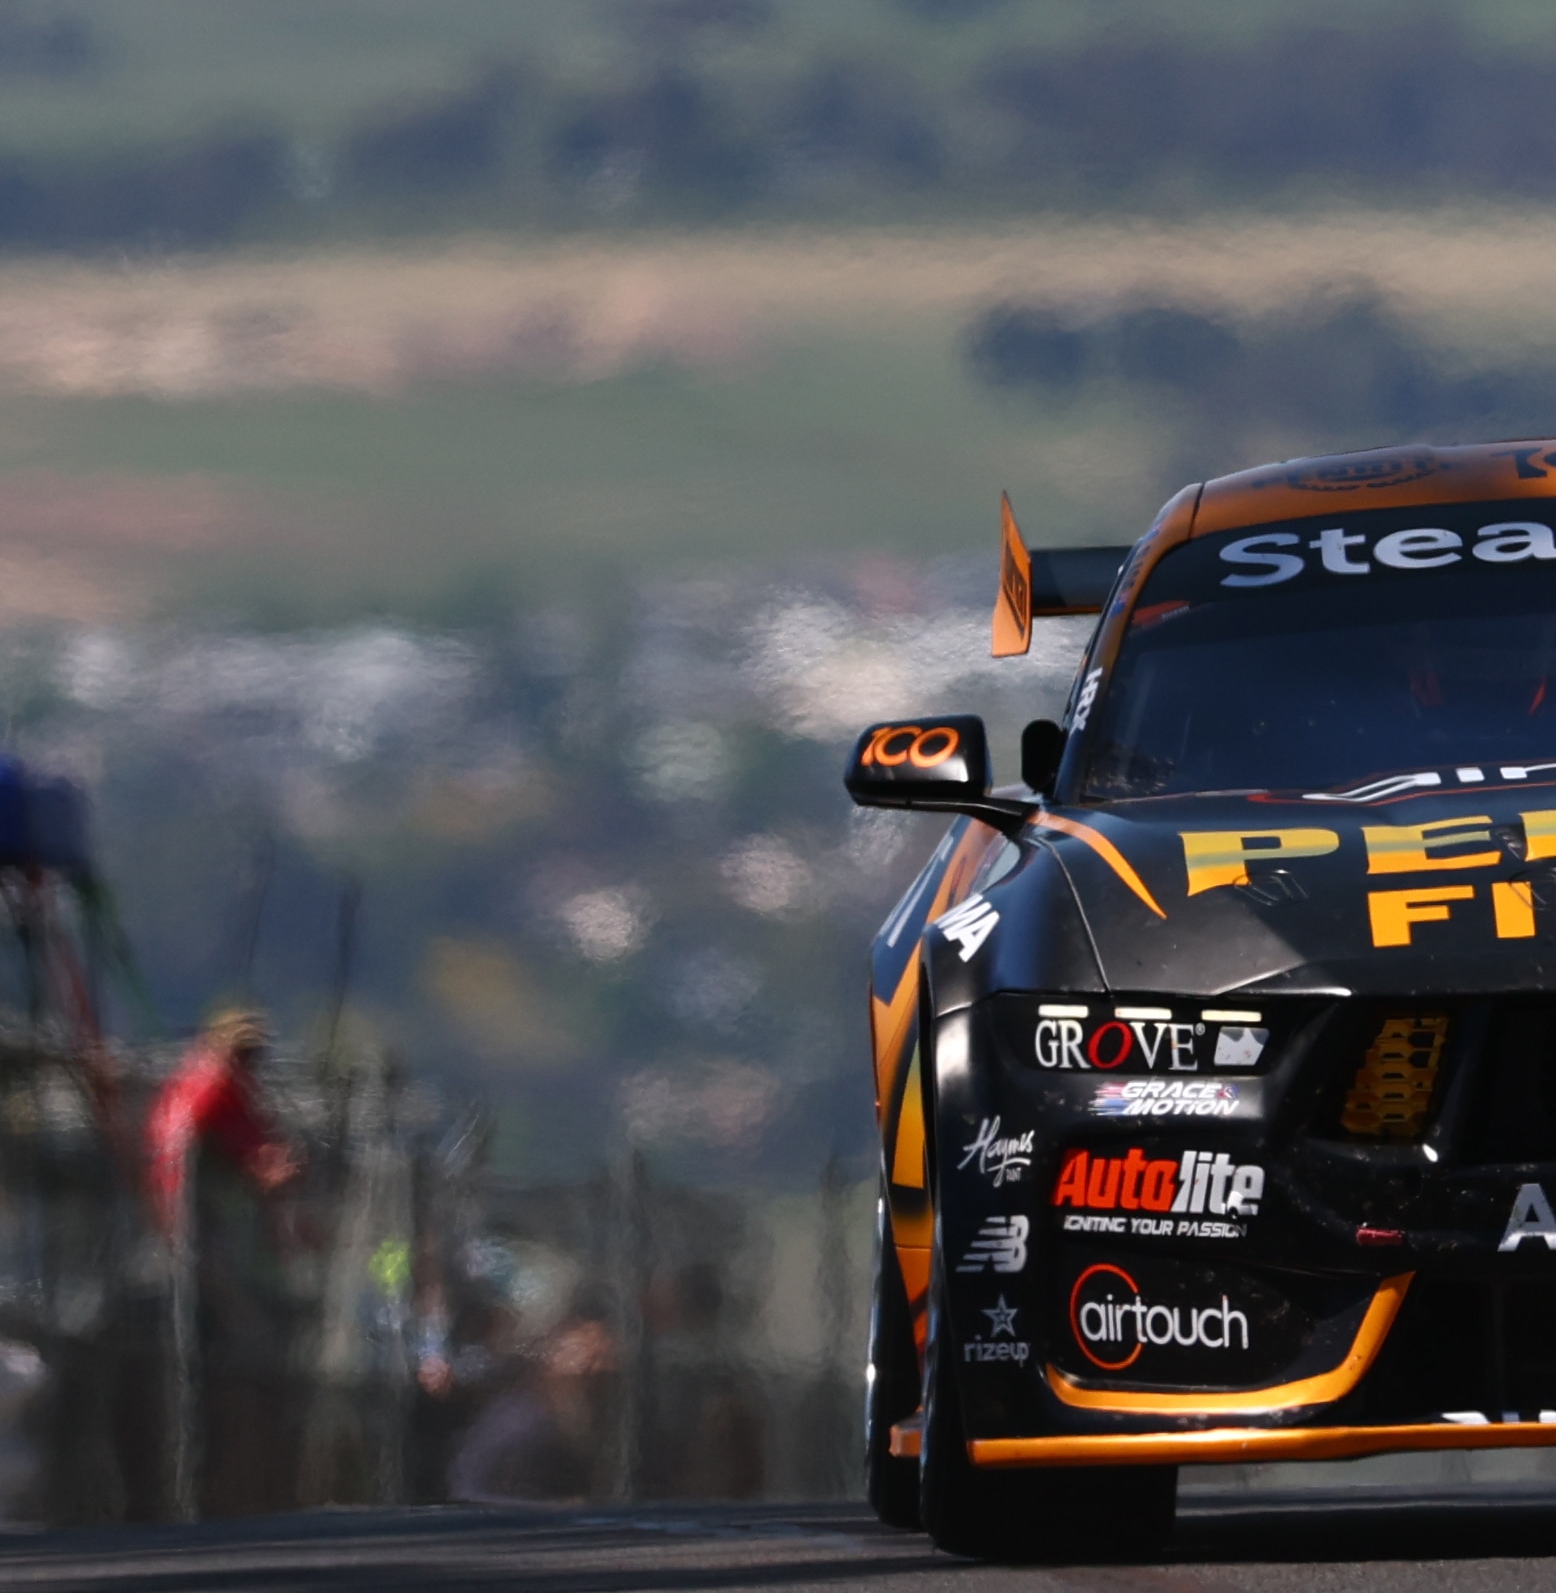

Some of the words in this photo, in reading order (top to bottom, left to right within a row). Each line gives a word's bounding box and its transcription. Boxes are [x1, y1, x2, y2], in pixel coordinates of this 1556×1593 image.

[1034, 1019, 1200, 1071] GROVE
[1120, 1081, 1222, 1099] GRACE
[1055, 1147, 1266, 1217] Autolite
[1063, 1215, 1128, 1233] IGNITING
[1131, 1218, 1174, 1236] YOUR
[1079, 1294, 1250, 1350] airtouch
[963, 1334, 1031, 1368] rizeup
